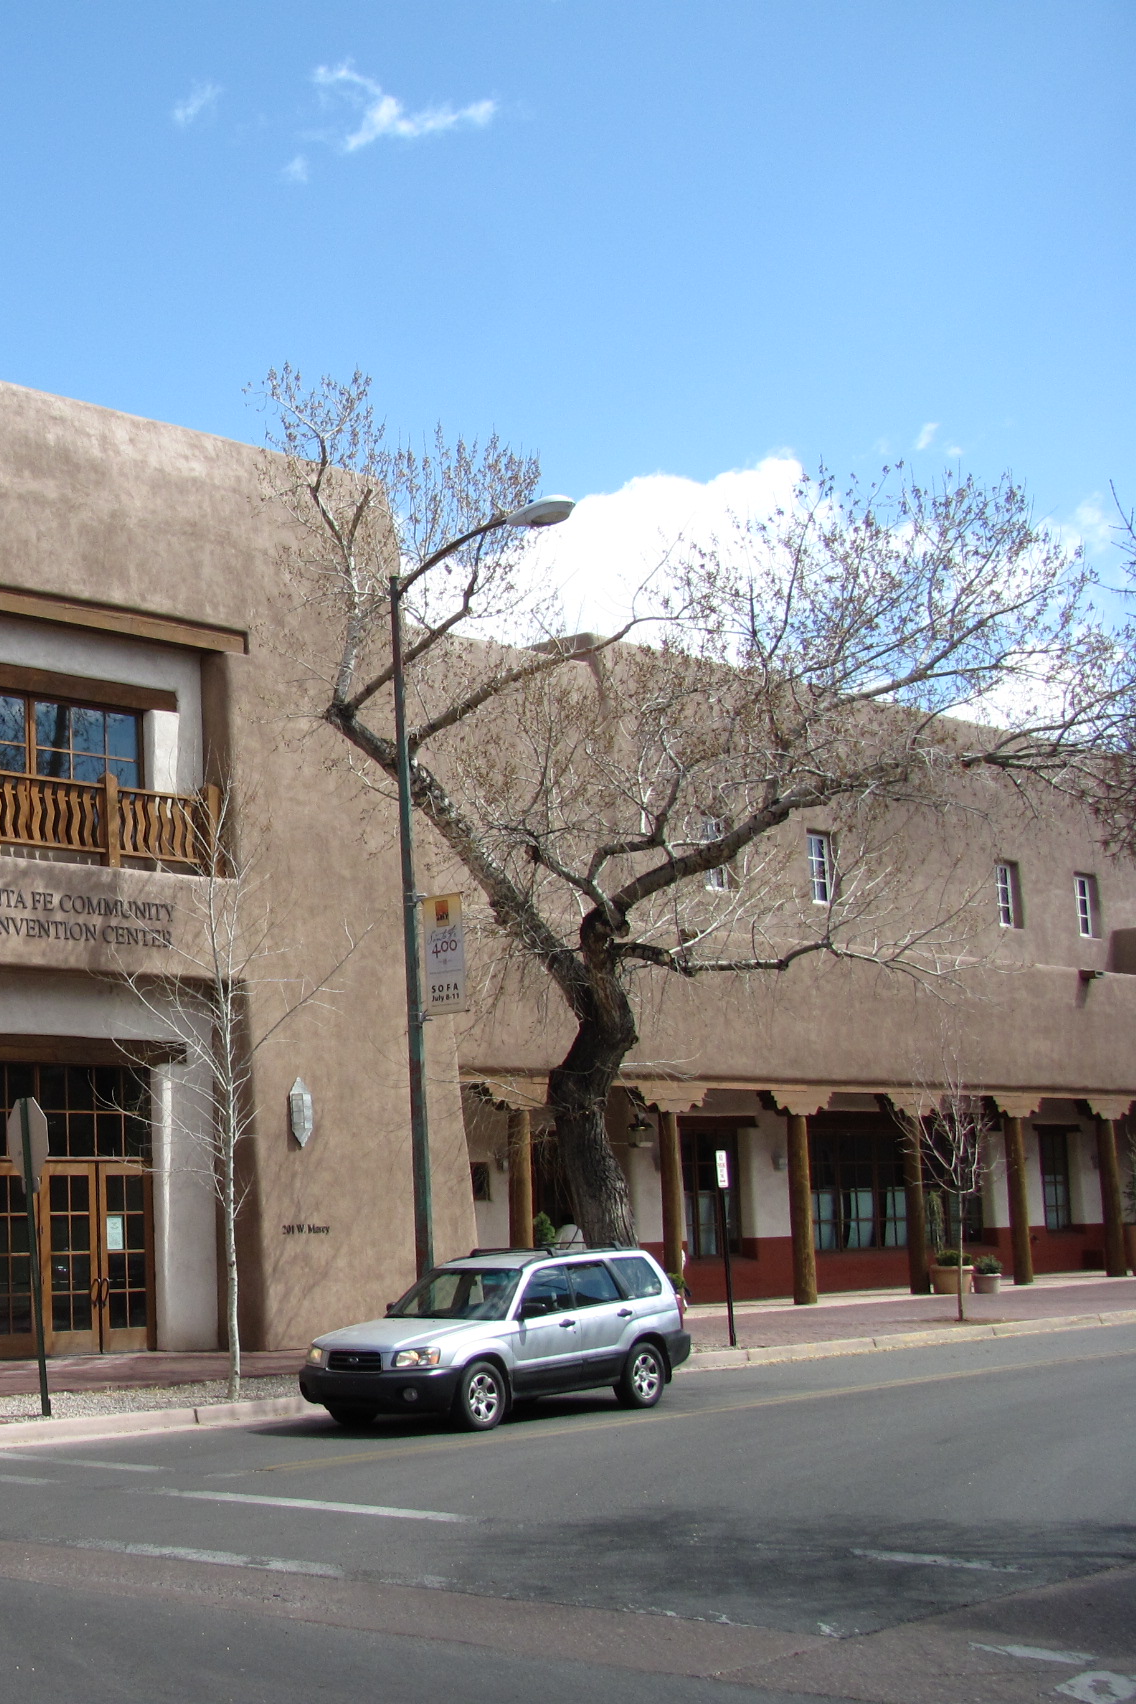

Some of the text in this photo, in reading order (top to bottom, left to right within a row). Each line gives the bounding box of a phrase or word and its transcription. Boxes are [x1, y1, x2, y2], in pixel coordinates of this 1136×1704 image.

[31, 892, 54, 912] FE
[60, 894, 175, 922] COMMUNITY
[102, 925, 173, 949] CENTER
[432, 939, 458, 958] 400
[431, 994, 444, 1002] July
[282, 1224, 294, 1235] 201
